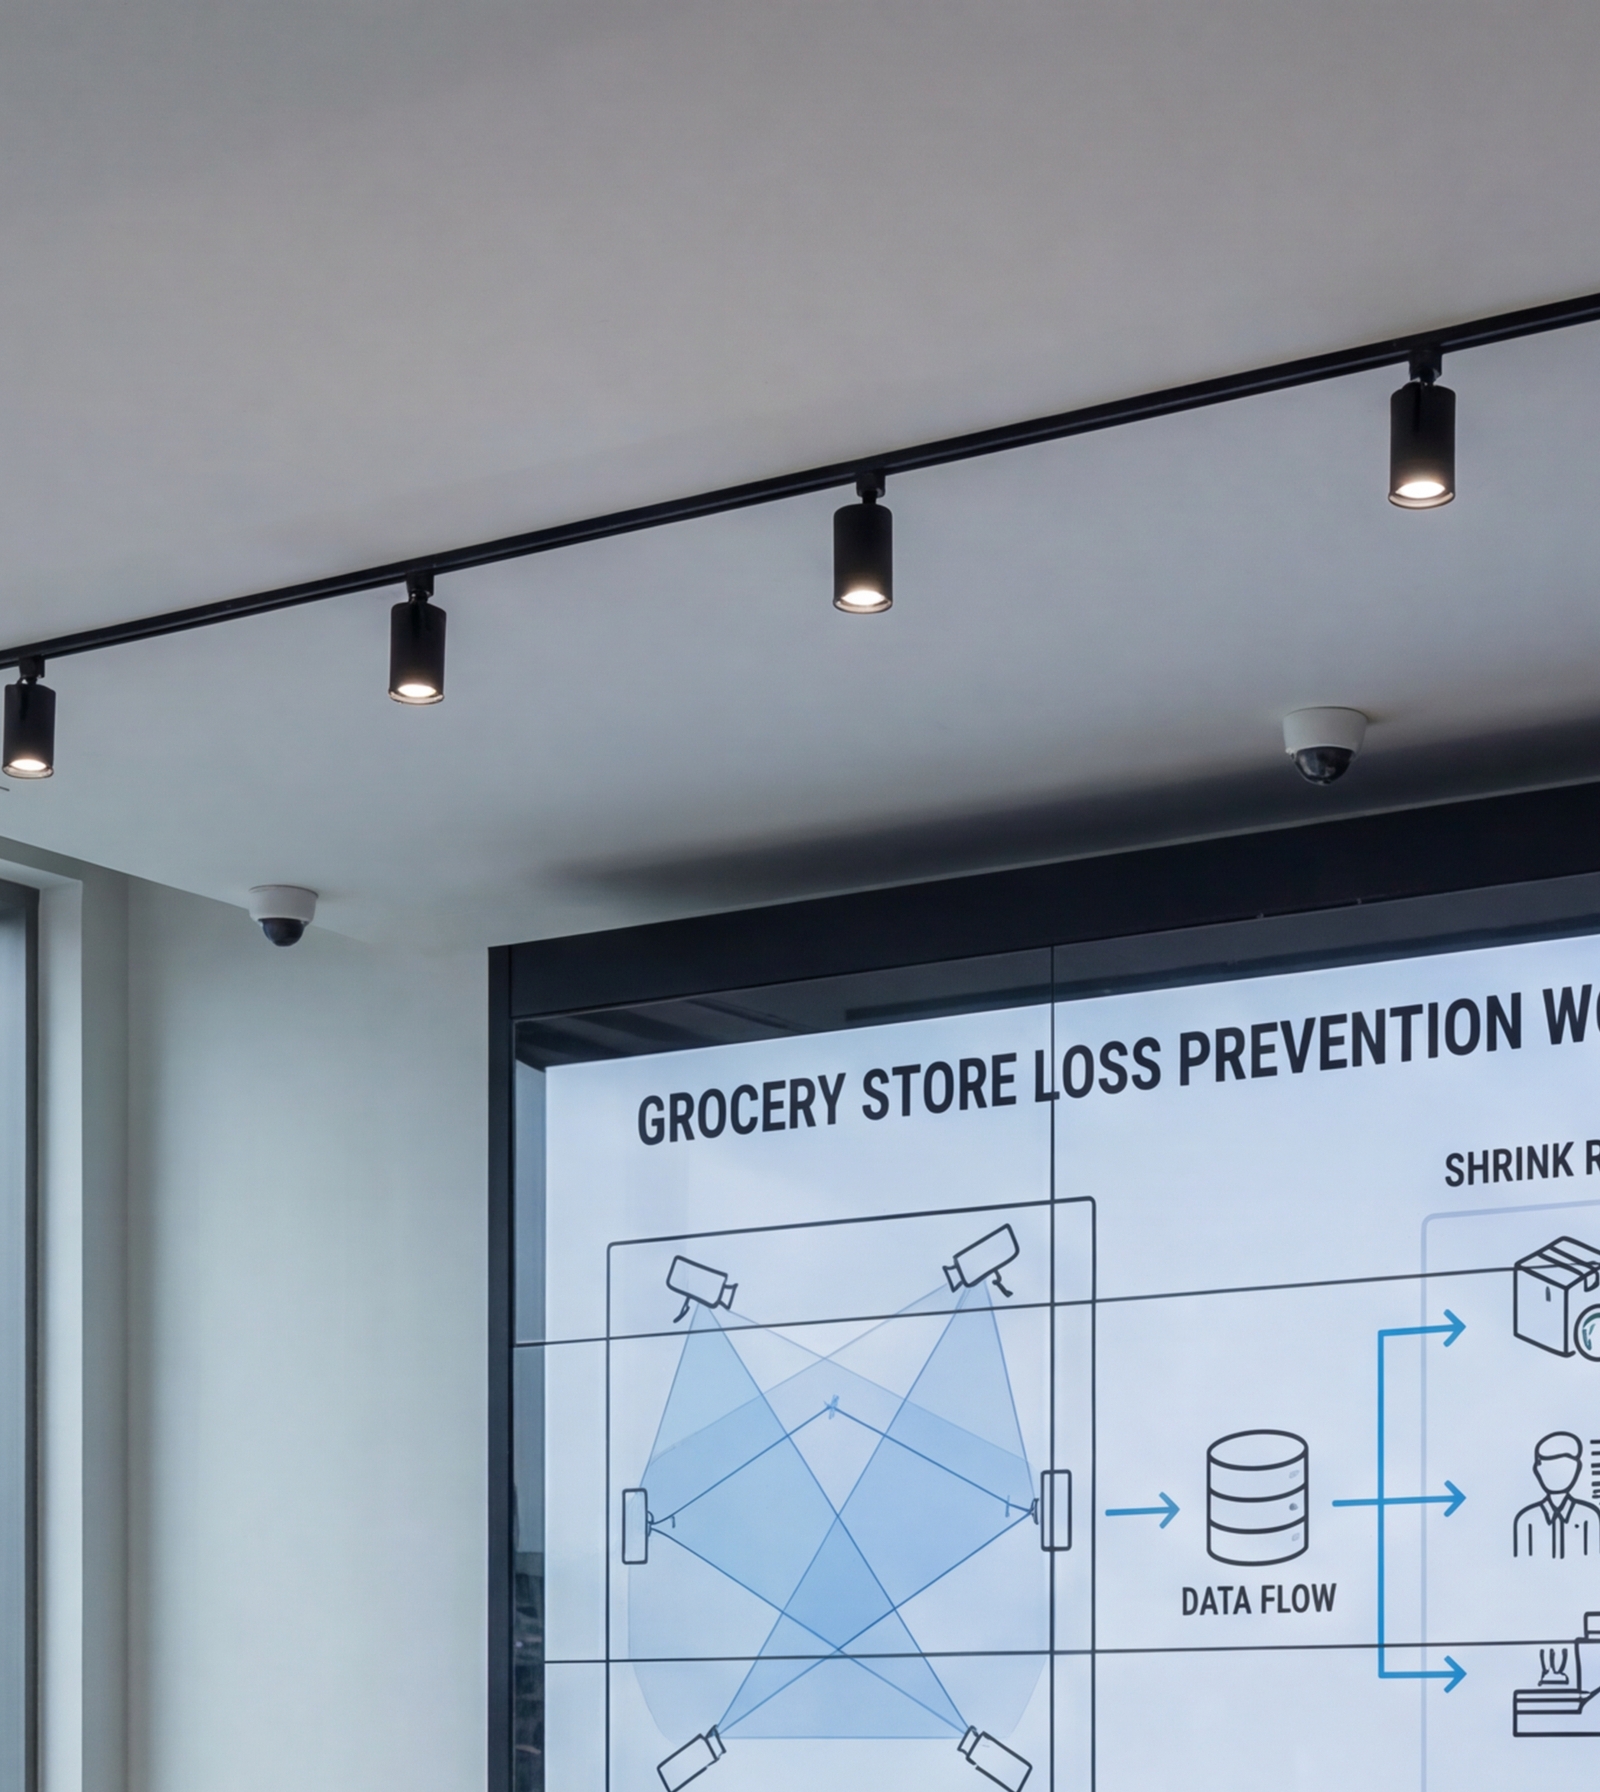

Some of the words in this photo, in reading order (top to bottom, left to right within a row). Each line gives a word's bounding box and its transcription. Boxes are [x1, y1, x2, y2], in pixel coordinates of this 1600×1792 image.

[638, 1072, 847, 1146] GROCERY
[862, 1052, 1017, 1121] STORE
[1035, 1037, 1160, 1104] LOSS
[1179, 994, 1522, 1087] PREVENTION
[1445, 1141, 1574, 1188] SHRINK
[1182, 1585, 1252, 1616] DATA
[1261, 1583, 1337, 1614] FLOW
